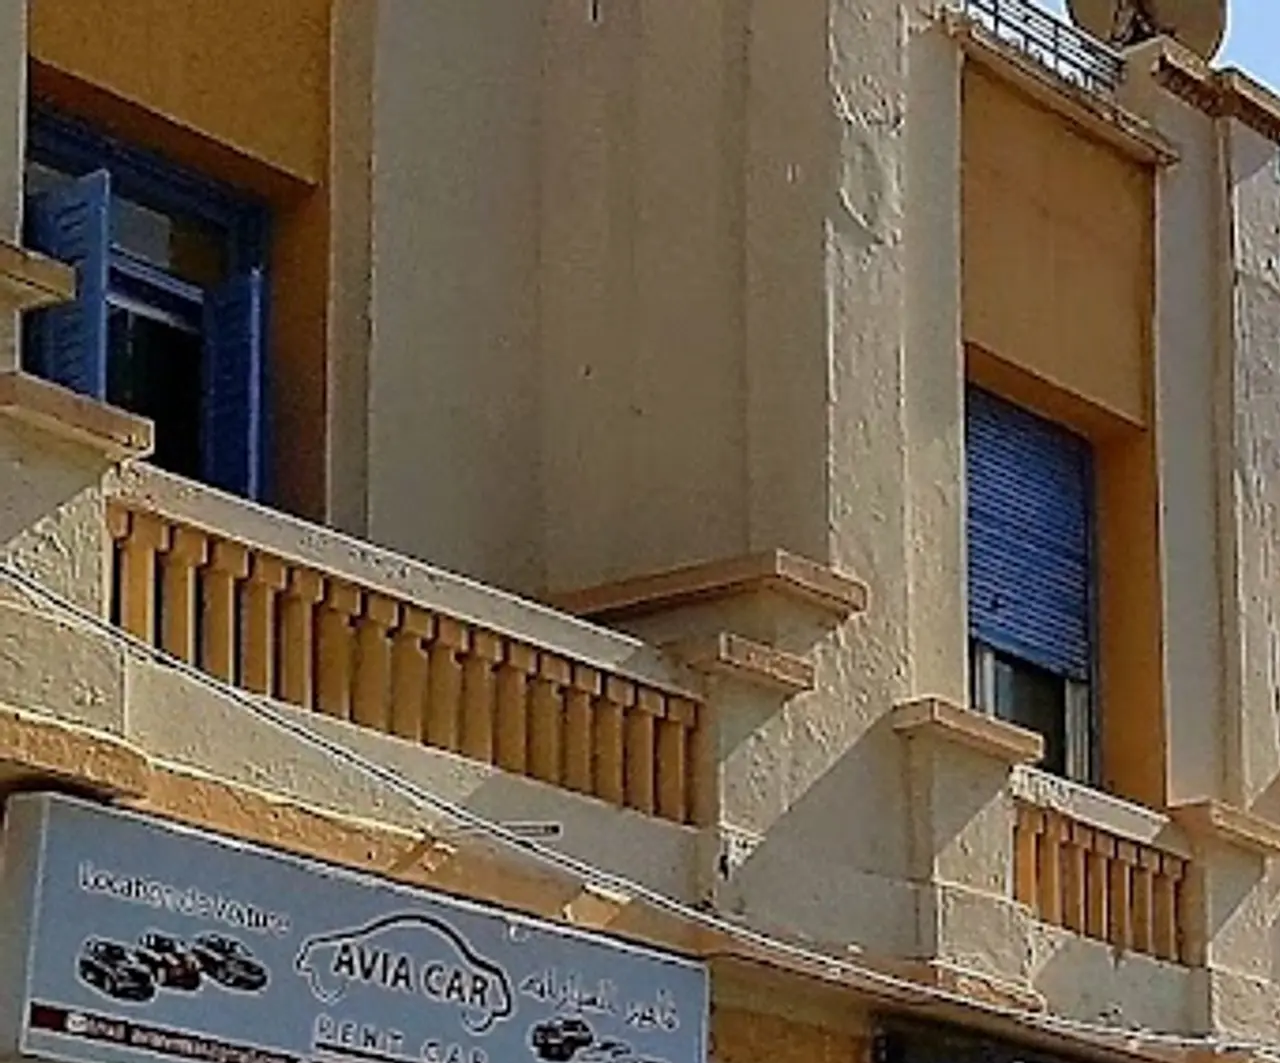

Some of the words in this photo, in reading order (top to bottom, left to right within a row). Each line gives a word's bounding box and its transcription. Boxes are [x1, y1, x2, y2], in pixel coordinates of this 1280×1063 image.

[333, 943, 413, 993] AVIA
[424, 962, 491, 1008] CAR
[315, 1013, 404, 1051] RENT
